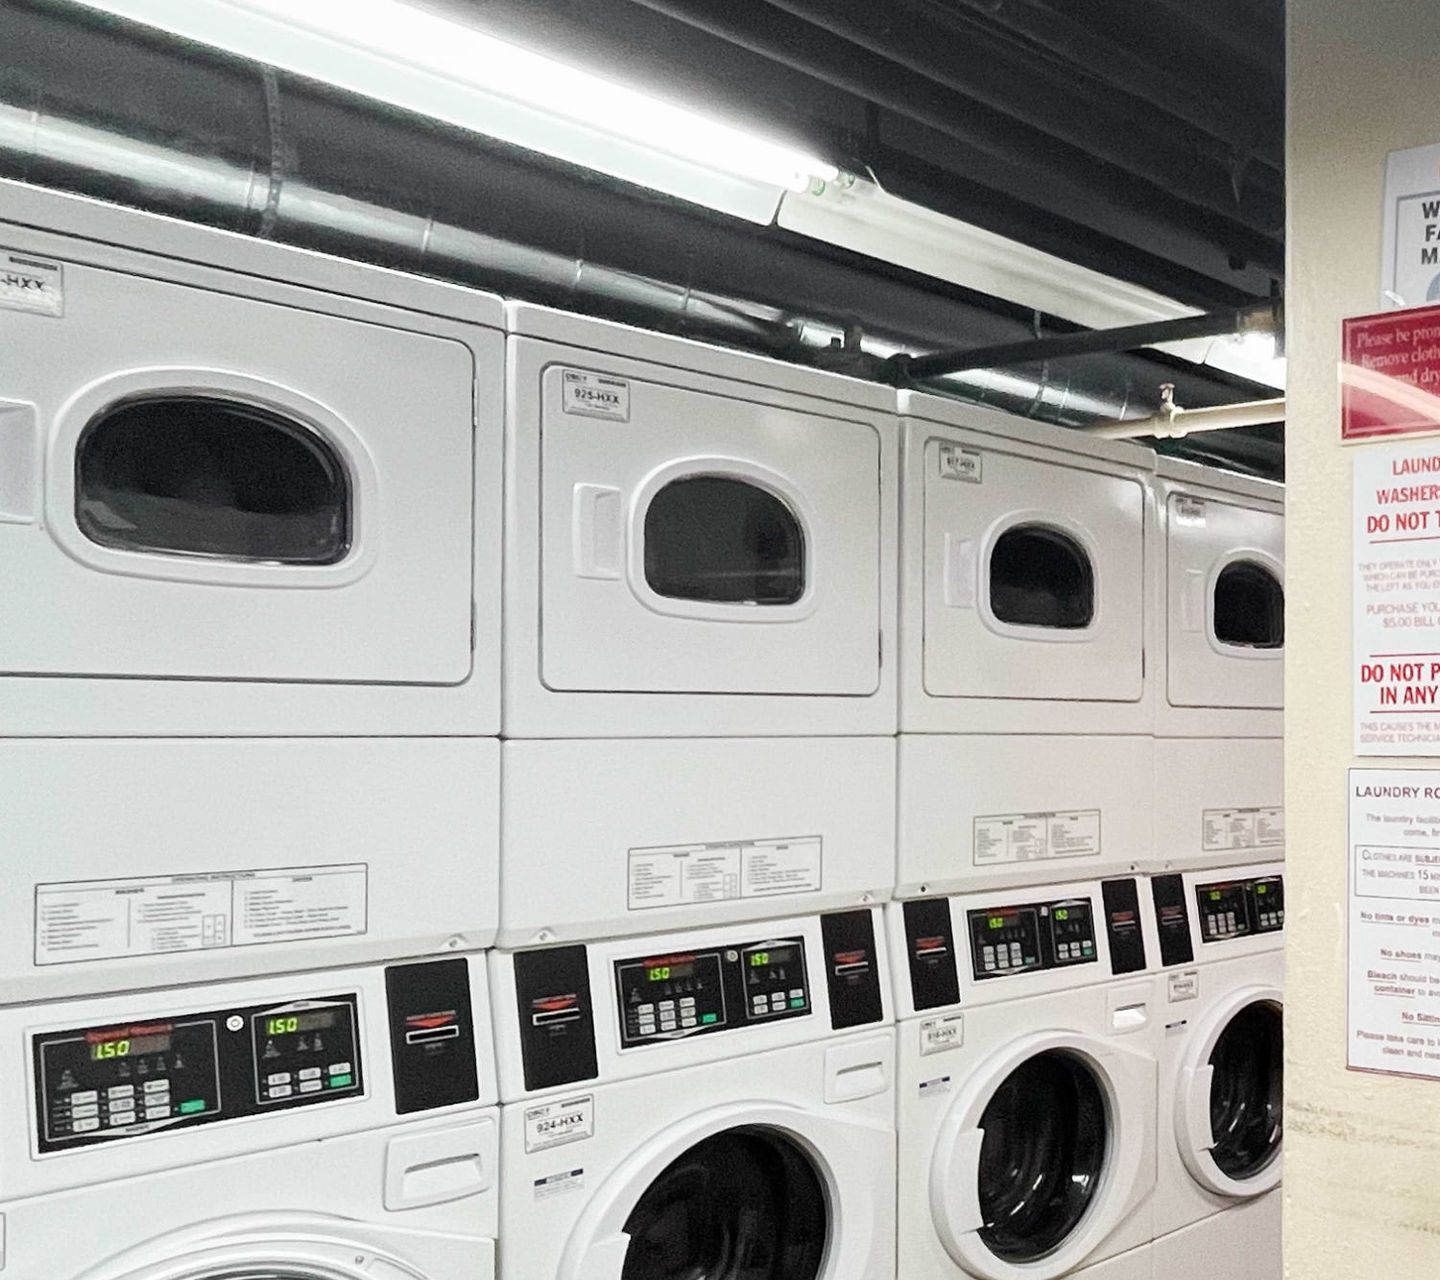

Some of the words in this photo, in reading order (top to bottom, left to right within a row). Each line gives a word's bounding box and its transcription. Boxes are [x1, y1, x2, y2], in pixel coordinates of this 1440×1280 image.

[1357, 331, 1393, 348] Please
[1395, 329, 1410, 342] be
[1361, 352, 1408, 369] Remove
[1367, 514, 1389, 533] DO
[1396, 511, 1429, 531] NOT
[1367, 603, 1418, 614] PURCHASE
[1414, 616, 1434, 627] BILL
[1361, 665, 1383, 682] DO
[1390, 664, 1424, 681] NOT
[1380, 687, 1397, 704] IN
[1403, 685, 1438, 704] ANY
[1356, 786, 1420, 798] LAUNDRY
[1418, 870, 1428, 880] 15
[537, 1112, 583, 1133] 924-HXX
